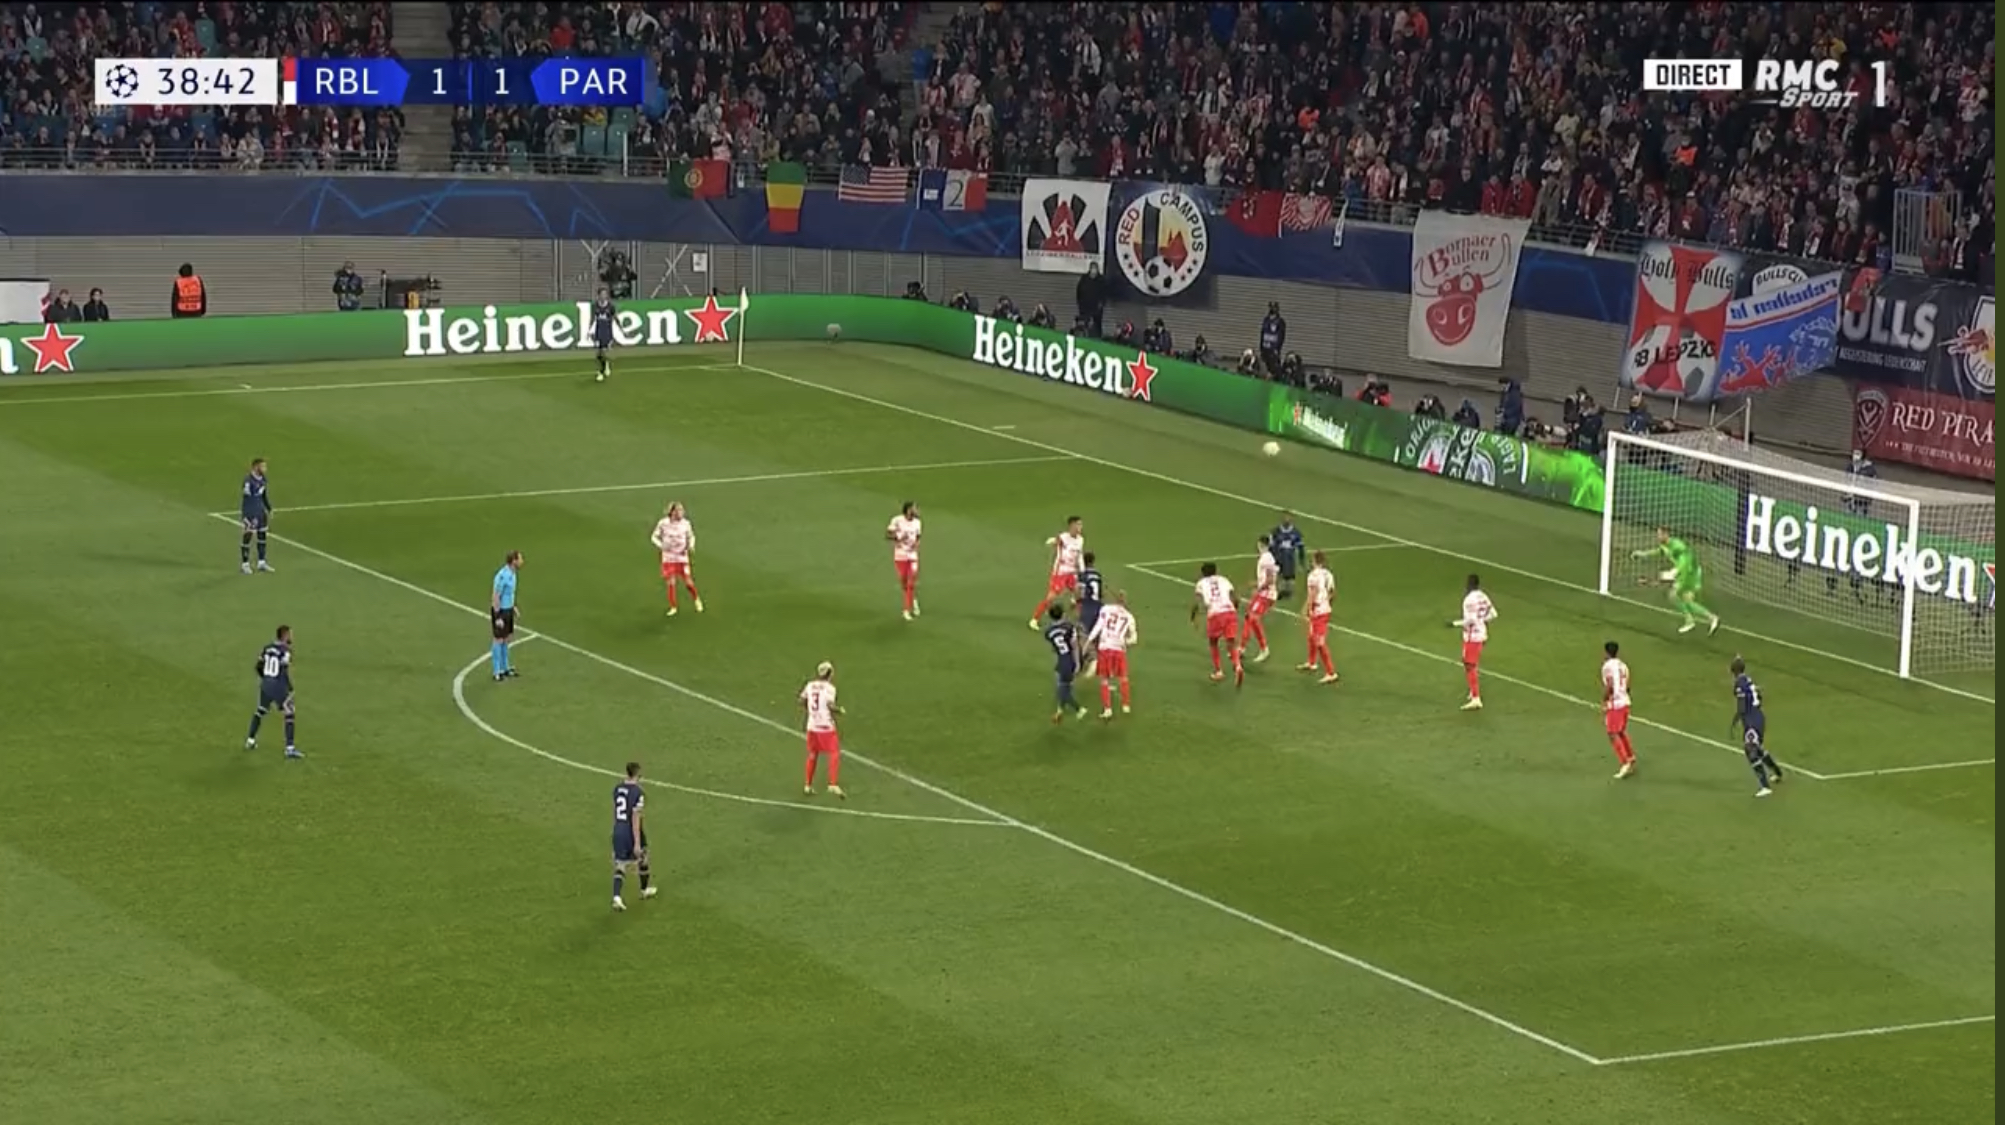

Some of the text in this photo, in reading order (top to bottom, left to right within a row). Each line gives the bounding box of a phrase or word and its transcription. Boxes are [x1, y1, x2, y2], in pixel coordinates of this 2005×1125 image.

[947, 180, 964, 207] 2
[1118, 193, 1205, 252] RED CAMPUS
[973, 314, 1124, 394] Heineken
[1891, 402, 1936, 433] RED
[1746, 493, 1977, 603] Heineken
[1106, 613, 1129, 635] 27
[1053, 635, 1069, 655] 5
[263, 654, 281, 677] 10
[811, 692, 820, 711] 3
[616, 796, 627, 820] 2
